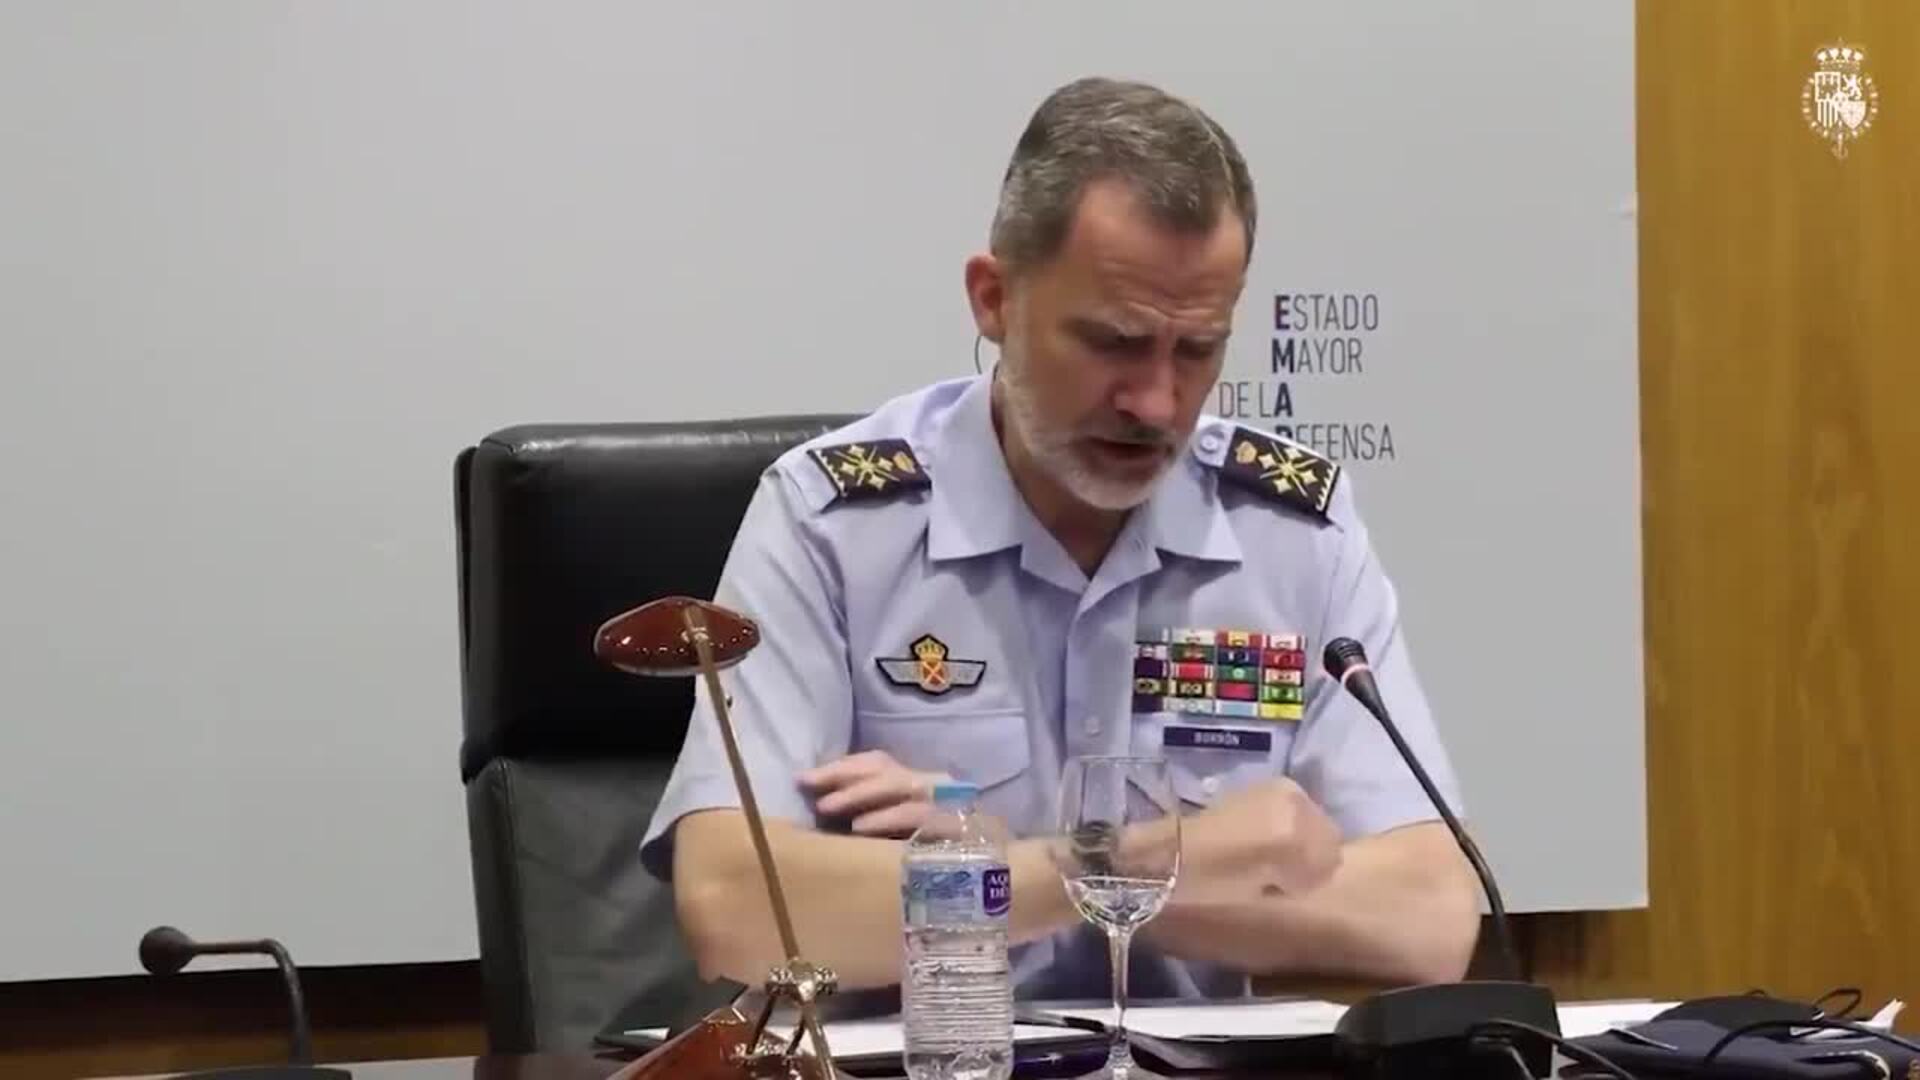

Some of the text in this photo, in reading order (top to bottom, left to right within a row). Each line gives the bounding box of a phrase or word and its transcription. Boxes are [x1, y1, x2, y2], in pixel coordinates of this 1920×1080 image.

[1274, 294, 1379, 331] ESTADO
[1272, 338, 1363, 374] MAYOR
[1219, 381, 1293, 418] DE LA
